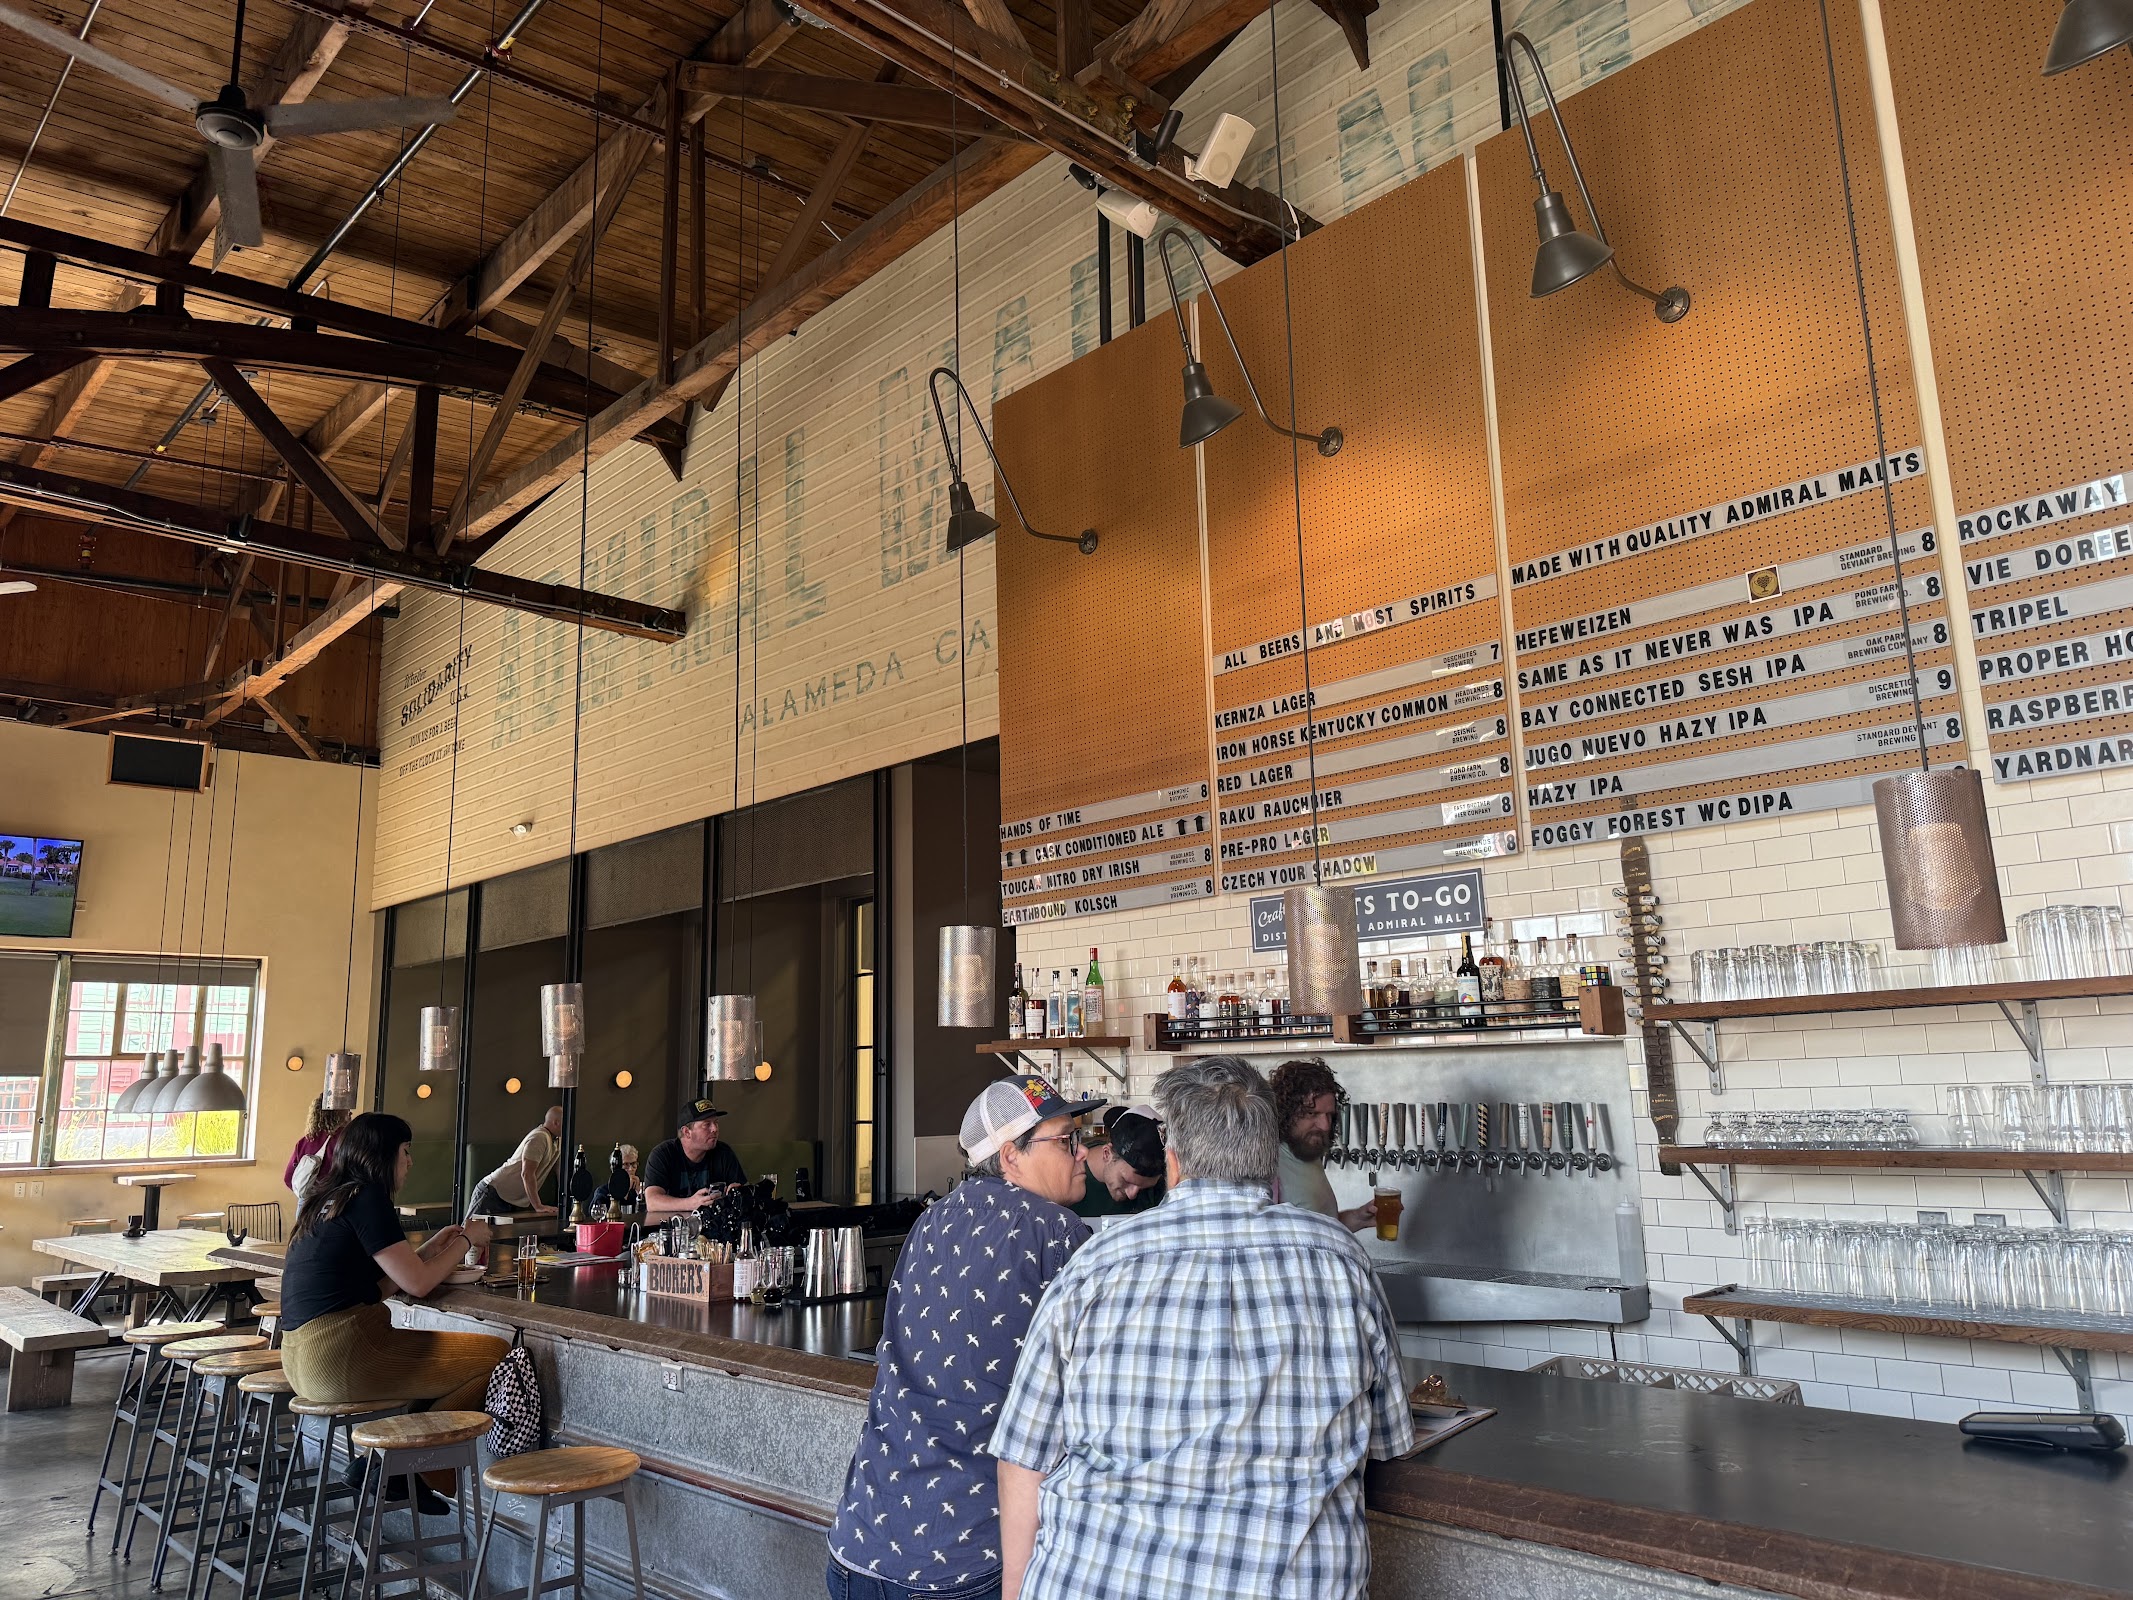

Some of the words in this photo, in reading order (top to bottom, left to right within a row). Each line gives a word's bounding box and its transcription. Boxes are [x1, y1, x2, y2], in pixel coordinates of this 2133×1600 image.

[1512, 556, 1562, 585] MADE
[1569, 538, 1620, 568] WITH
[1627, 510, 1712, 551] QUALITY
[1726, 480, 1827, 524] ADMIRAL
[1838, 452, 1920, 492] MALTS
[1958, 479, 2121, 540] ROCKAWAY
[1921, 532, 1935, 552] 8
[1839, 545, 1883, 562] STANDARD
[1840, 556, 1875, 571] DEVIANT
[1877, 545, 1916, 562] BREING
[1967, 557, 2011, 585] VIE
[2035, 529, 2131, 570] DOREE
[1855, 588, 1878, 600] POND
[1926, 576, 1940, 597] 8
[1856, 593, 1894, 608] BREWING
[1972, 596, 2068, 633] TRIPEL
[1225, 651, 1247, 670] ALL
[1260, 634, 1300, 659] BEERS
[1353, 607, 1393, 631] MOST
[1410, 583, 1475, 616] SPIRITS
[1515, 607, 1632, 651] HEFEWEIZEN
[1933, 623, 1947, 644] 8
[1518, 663, 1568, 689] SAME
[1579, 655, 1604, 677] AS
[1615, 649, 1632, 669] IT
[1645, 630, 1712, 661] NEVER
[1722, 616, 1773, 644] WAS
[1793, 602, 1834, 627] IPA
[1847, 644, 1886, 659] BREWING
[1887, 636, 1928, 651] COMANY
[1866, 636, 1883, 647] OAK
[1884, 632, 1907, 643] PARK
[1443, 650, 1477, 664] DESCHUTES
[1491, 644, 1499, 659] 7
[1978, 641, 2089, 680] PROPER
[400, 644, 473, 727] SOLIDARITY
[1494, 682, 1503, 698] 8
[1868, 677, 1920, 694] DISCRETION
[1937, 669, 1951, 690] 9
[739, 651, 905, 735] ALAMEDA
[1454, 694, 1480, 705] BREWING
[1455, 685, 1489, 698] HEADLANDS
[1521, 704, 1559, 728] BAY
[1569, 679, 1685, 719] CONNECTED
[1698, 665, 1753, 692] SESH
[1766, 653, 1806, 679] IPA
[1875, 687, 1915, 702] BREWING
[1215, 705, 1265, 729] KERNZA
[1273, 692, 1316, 715] LAGER
[1216, 742, 1246, 760] IRON
[1252, 731, 1295, 753] HORSE
[1300, 711, 1377, 742] KENTUCKY
[1381, 694, 1448, 723] COMMON
[1453, 727, 1477, 737] SEISMIC
[1496, 719, 1505, 735] 8
[1525, 742, 1572, 767] JUGO
[1581, 729, 1646, 758] NUEVO
[1659, 715, 1717, 744] HAZY
[1728, 707, 1767, 731] IPA
[1857, 727, 1900, 742] STANDARD
[1902, 721, 1938, 735] DEVANT
[1946, 717, 1960, 738] 8
[1452, 734, 1479, 744] BREWING
[1878, 734, 1916, 747] BREWING
[1449, 766, 1465, 776] POND
[1466, 764, 1482, 773] FARM
[1500, 756, 1510, 774] 8
[1217, 775, 1242, 793] RED
[1250, 765, 1293, 787] LAGER
[1450, 772, 1477, 782] BREWING
[1477, 770, 1488, 779] CO.
[1201, 784, 1208, 798] 8
[1528, 782, 1576, 807] HAZY
[1590, 775, 1624, 797] IPA
[1220, 805, 1255, 826] RAKU
[1263, 790, 1343, 819] RAUCHBIER
[1467, 807, 1492, 816] COMPANY
[1501, 796, 1511, 813] 8
[1000, 821, 1032, 839] HANDS
[1039, 817, 1051, 831] OF
[1057, 811, 1081, 826] TIME
[1531, 821, 1594, 847] FOGGY
[1608, 807, 1686, 836] FOREST
[1698, 800, 1731, 822] WC
[1738, 791, 1793, 817] DIPA
[1035, 845, 1062, 861] CASK
[1065, 830, 1136, 855] CONDITIONED
[1142, 824, 1164, 844] ALE
[1221, 836, 1277, 859] PRE-PRO
[1284, 826, 1330, 849] LAGER
[1455, 847, 1482, 857] BREWING
[1456, 838, 1491, 848] HEADLANDS
[1506, 834, 1516, 851] 8
[1170, 857, 1189, 866] BREWING
[1171, 850, 1195, 860] HEADLANDS
[1204, 848, 1211, 862] 8
[1046, 871, 1077, 888] NITRO
[1082, 865, 1103, 883] DRY
[1109, 860, 1140, 878] IRISH
[1221, 872, 1265, 890] CZECH
[1270, 865, 1306, 884] YOUR
[1312, 855, 1375, 878] SHADOW
[1171, 889, 1191, 899] BREWING
[1206, 879, 1212, 893] 8
[1385, 884, 1472, 912] TO-GO
[1003, 903, 1067, 924] EARTHBOUND
[1075, 895, 1118, 914] KOLSCH
[1368, 917, 1426, 932] ADMIRAL
[1435, 912, 1472, 925] MALT
[649, 1263, 703, 1294] BOOKER'S
